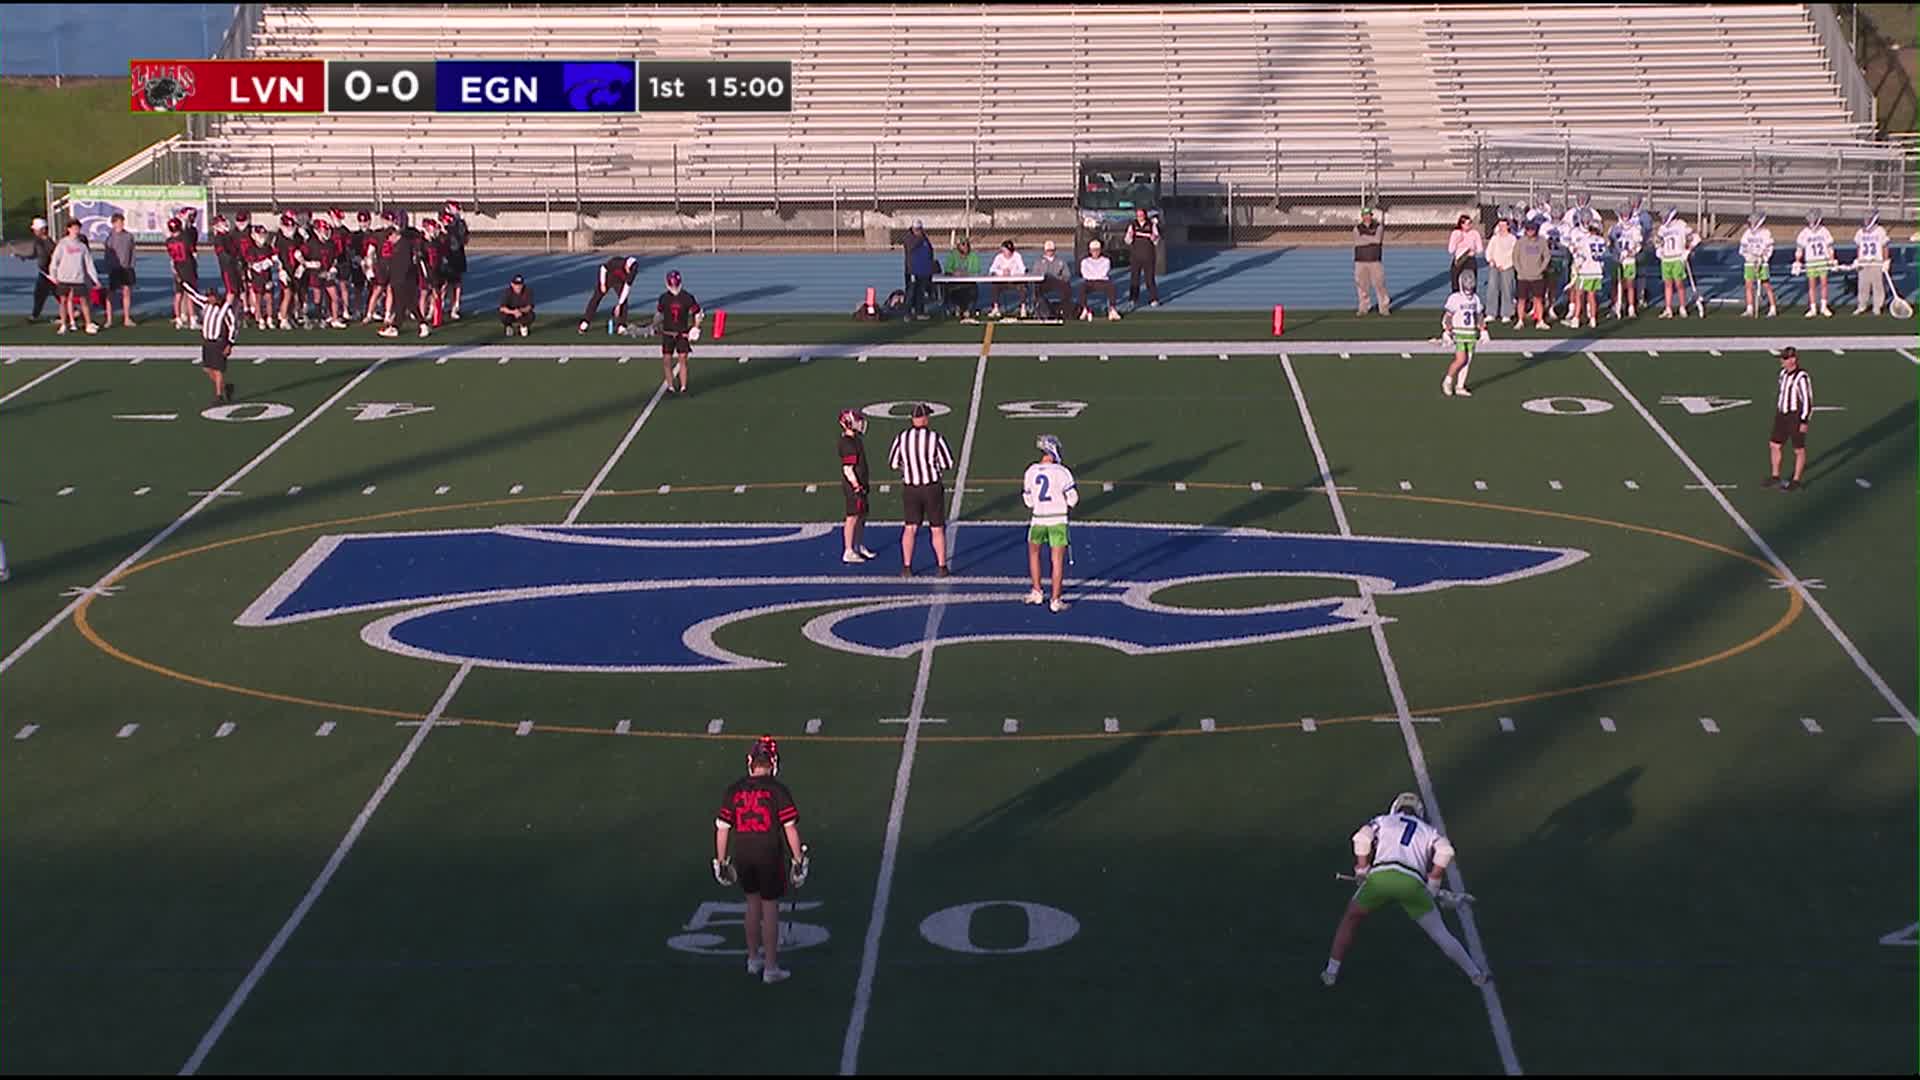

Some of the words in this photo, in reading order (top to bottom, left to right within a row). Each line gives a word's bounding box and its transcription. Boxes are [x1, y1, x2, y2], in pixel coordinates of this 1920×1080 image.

[1463, 311, 1472, 326] 3
[1035, 474, 1052, 502] 2
[1399, 817, 1418, 847] 7
